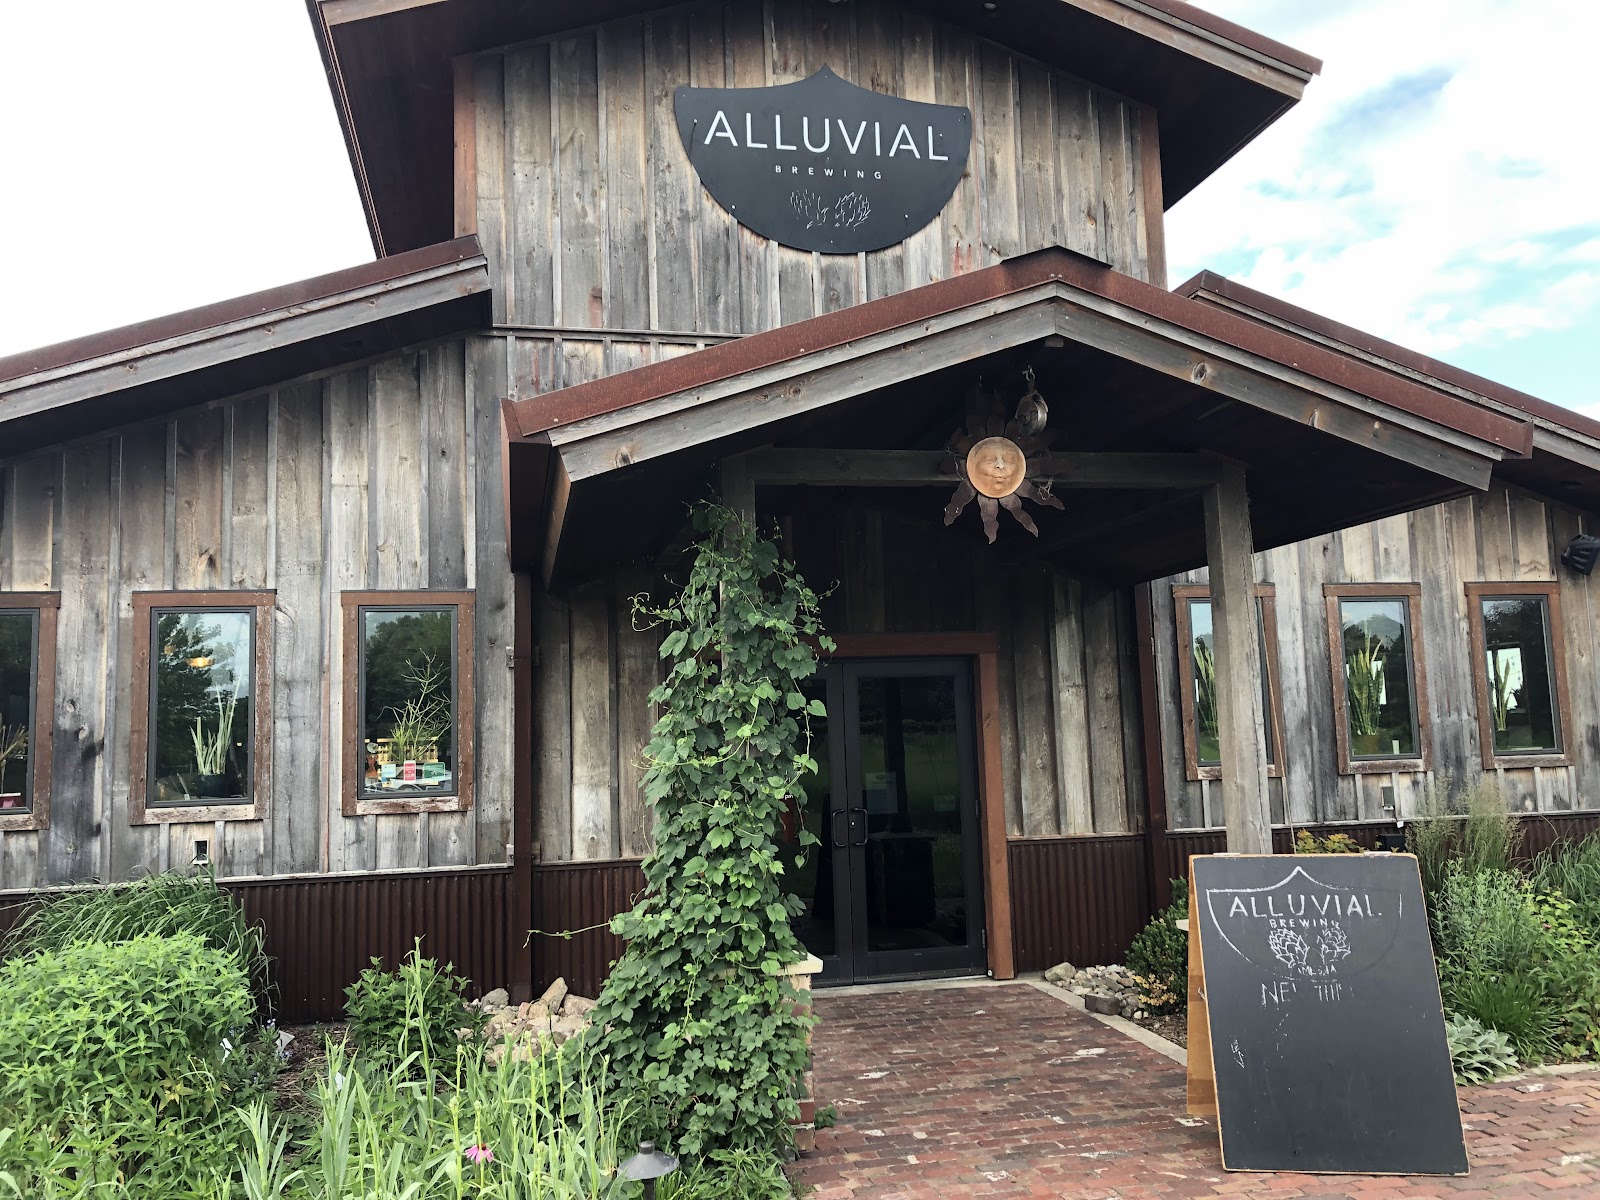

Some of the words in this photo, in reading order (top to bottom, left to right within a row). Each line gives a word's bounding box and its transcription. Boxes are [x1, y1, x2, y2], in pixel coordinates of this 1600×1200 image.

[703, 110, 949, 161] ALLUVIAL
[775, 164, 882, 180] BREWING
[1229, 893, 1382, 918] ALLUVIAL
[1269, 918, 1340, 928] BREWING
